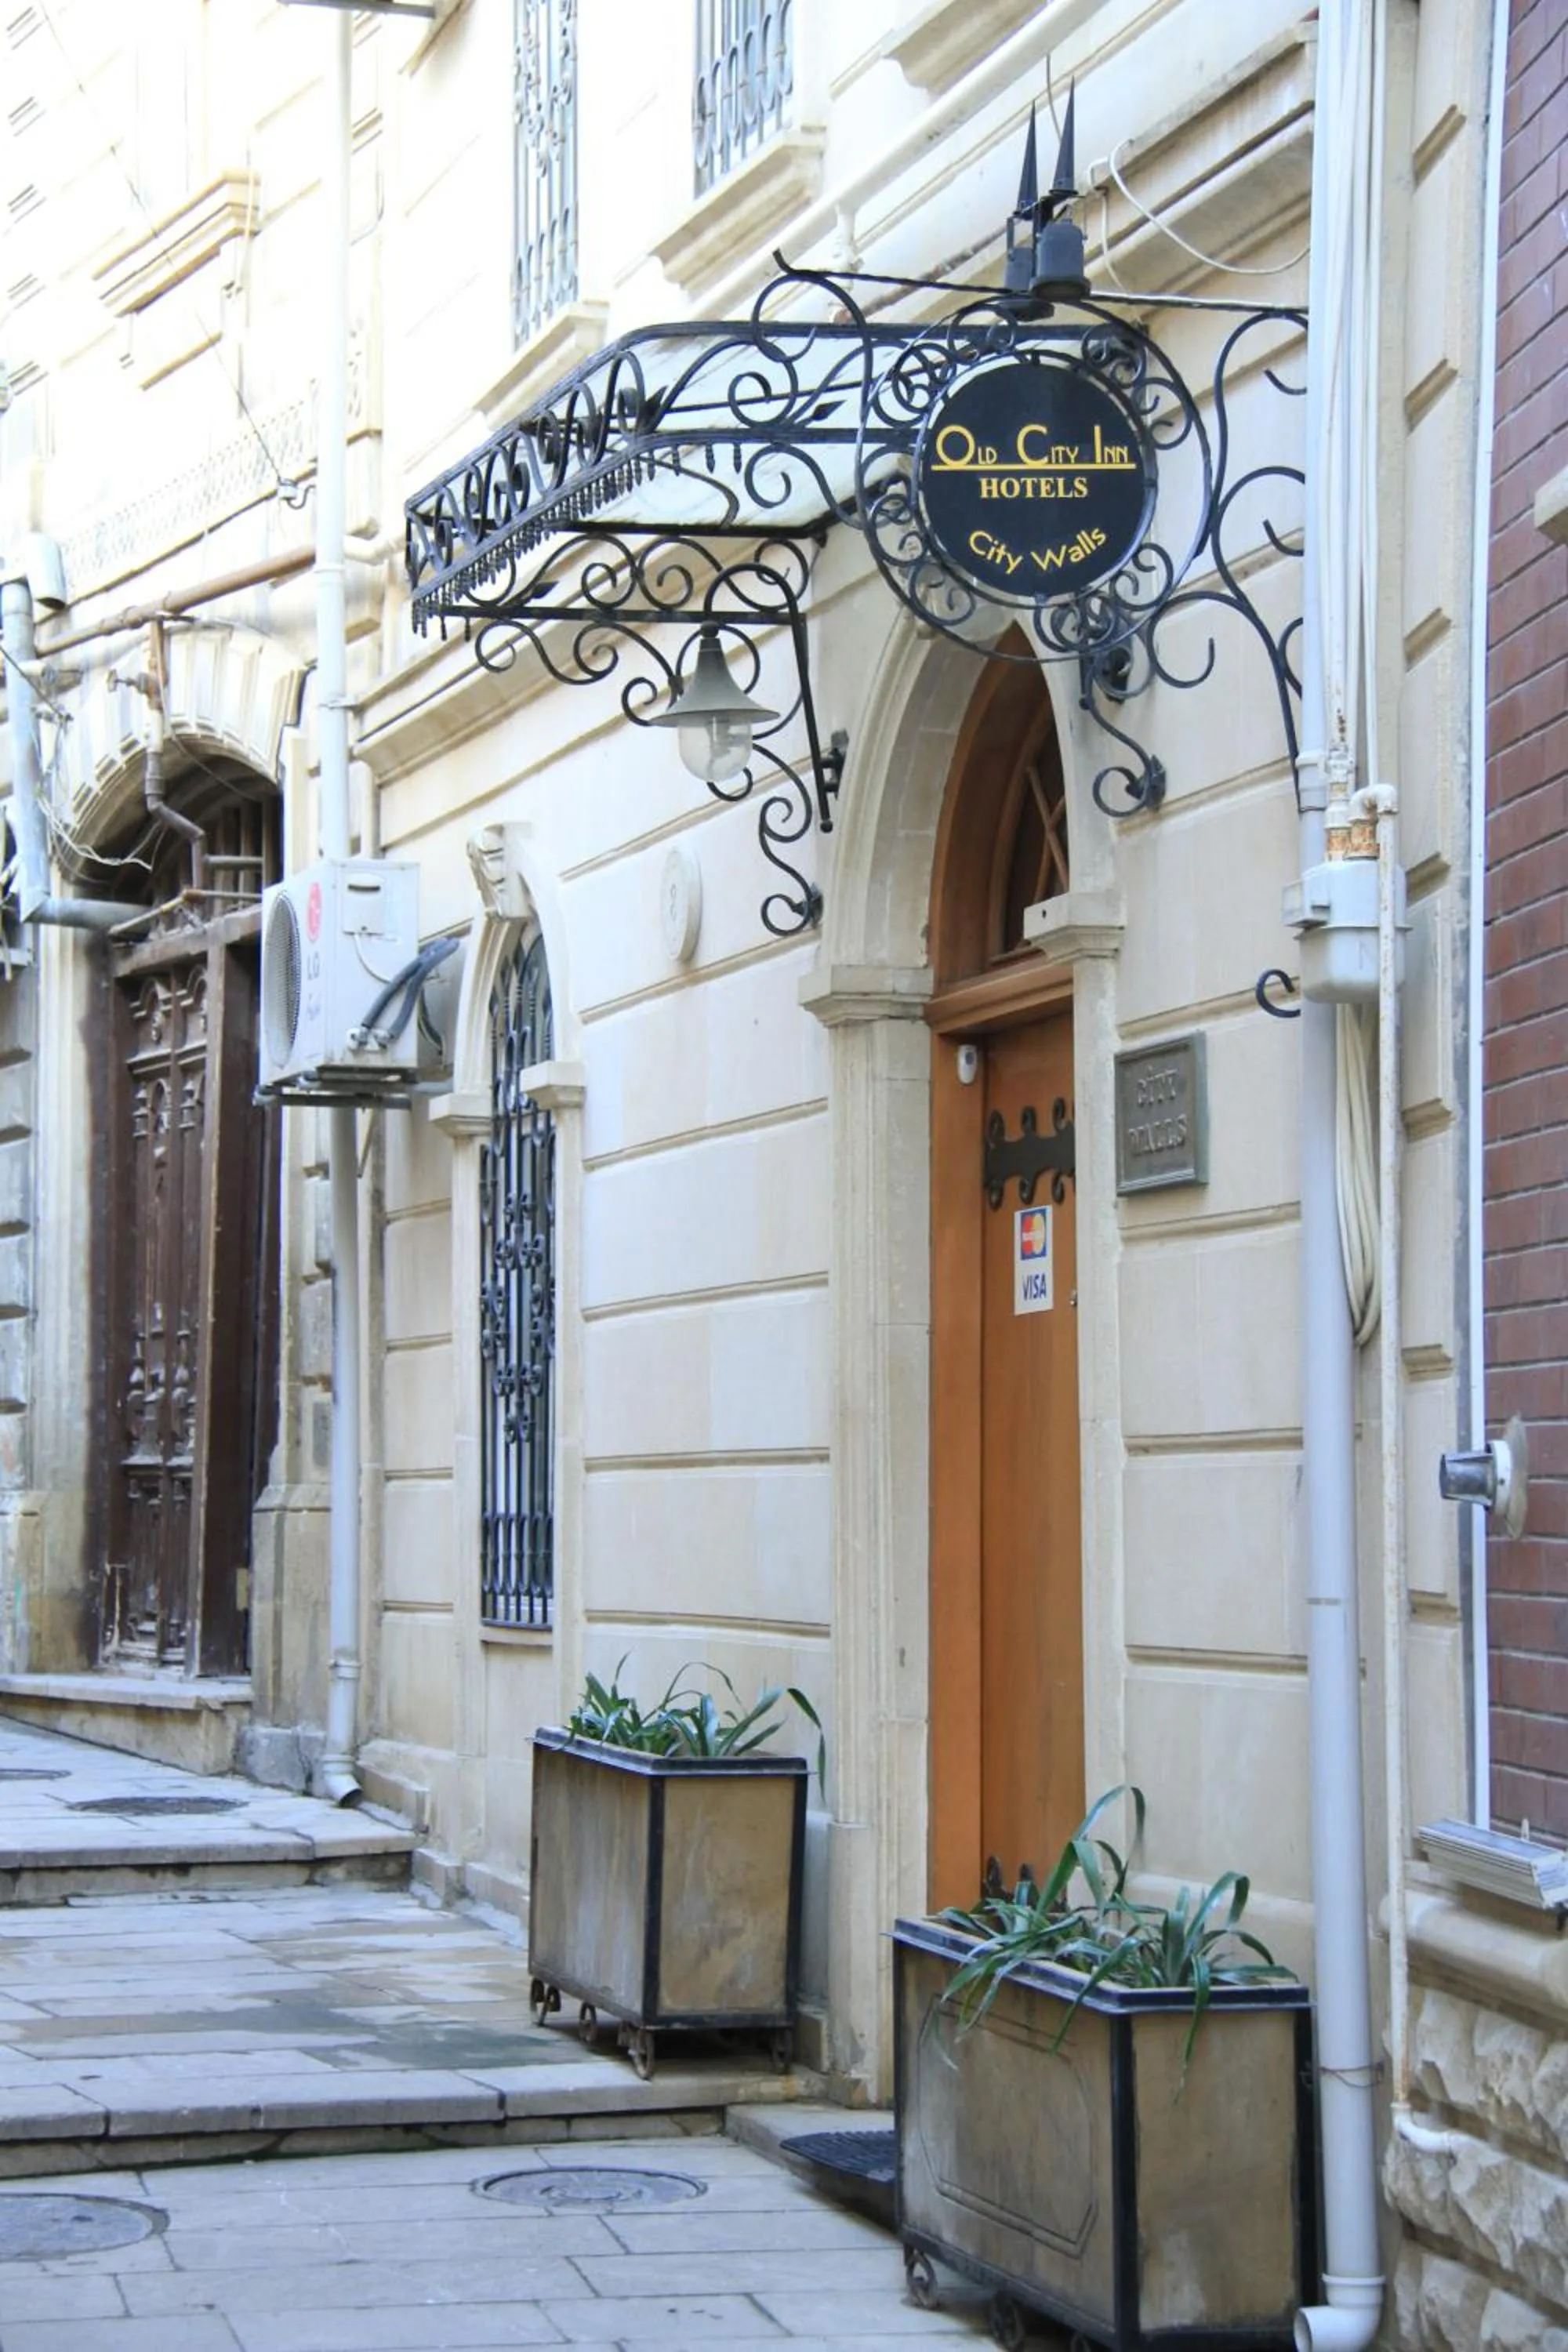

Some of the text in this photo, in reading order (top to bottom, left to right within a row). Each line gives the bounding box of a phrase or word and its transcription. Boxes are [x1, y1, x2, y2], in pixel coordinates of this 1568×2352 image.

[936, 424, 1128, 466] OLD CITY INN
[979, 477, 1088, 499] HOTELS
[969, 528, 1107, 575] City Walls
[1022, 1272, 1047, 1301] VISA
